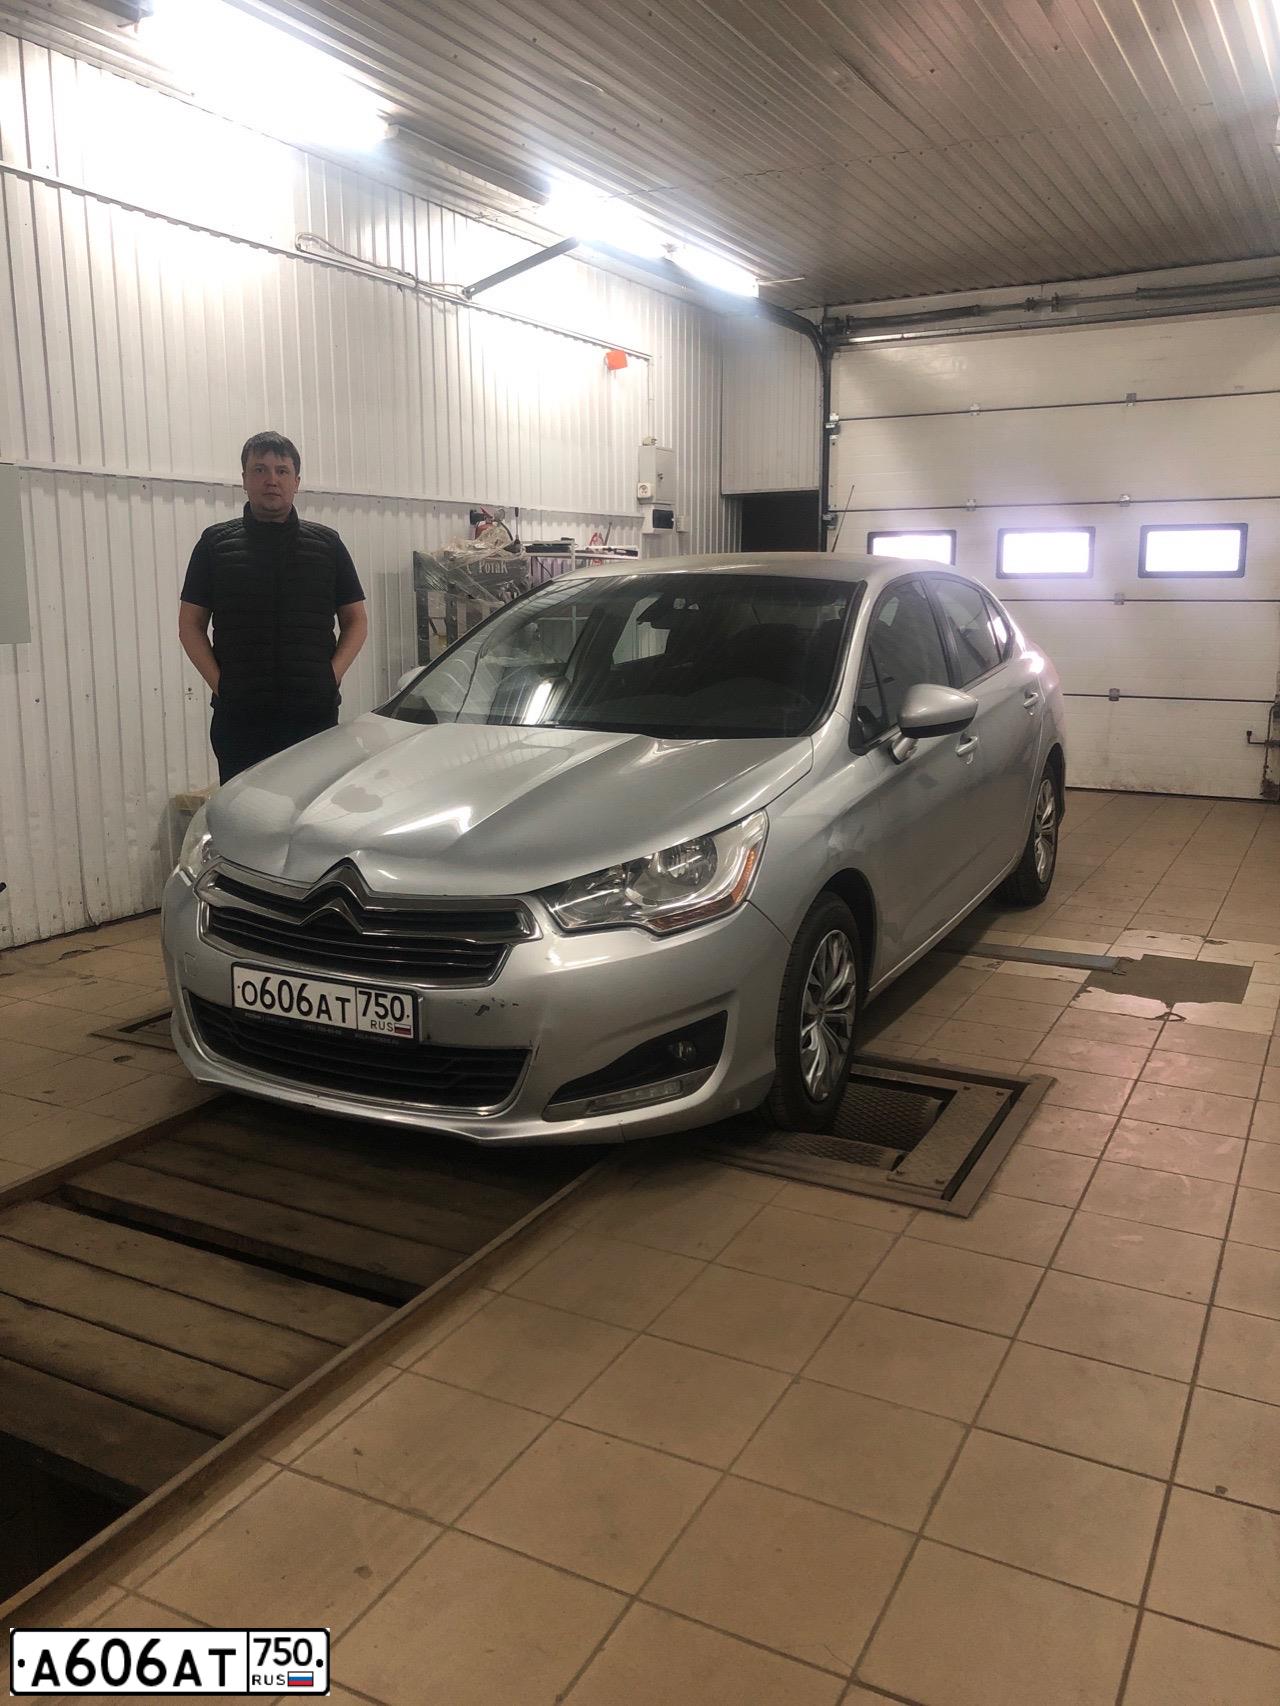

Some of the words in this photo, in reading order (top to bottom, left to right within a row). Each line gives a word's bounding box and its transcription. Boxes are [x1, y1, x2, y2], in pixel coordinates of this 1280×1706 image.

[241, 976, 351, 1024] О606АТ
[358, 990, 405, 1022] 750
[370, 1019, 394, 1033] RUS
